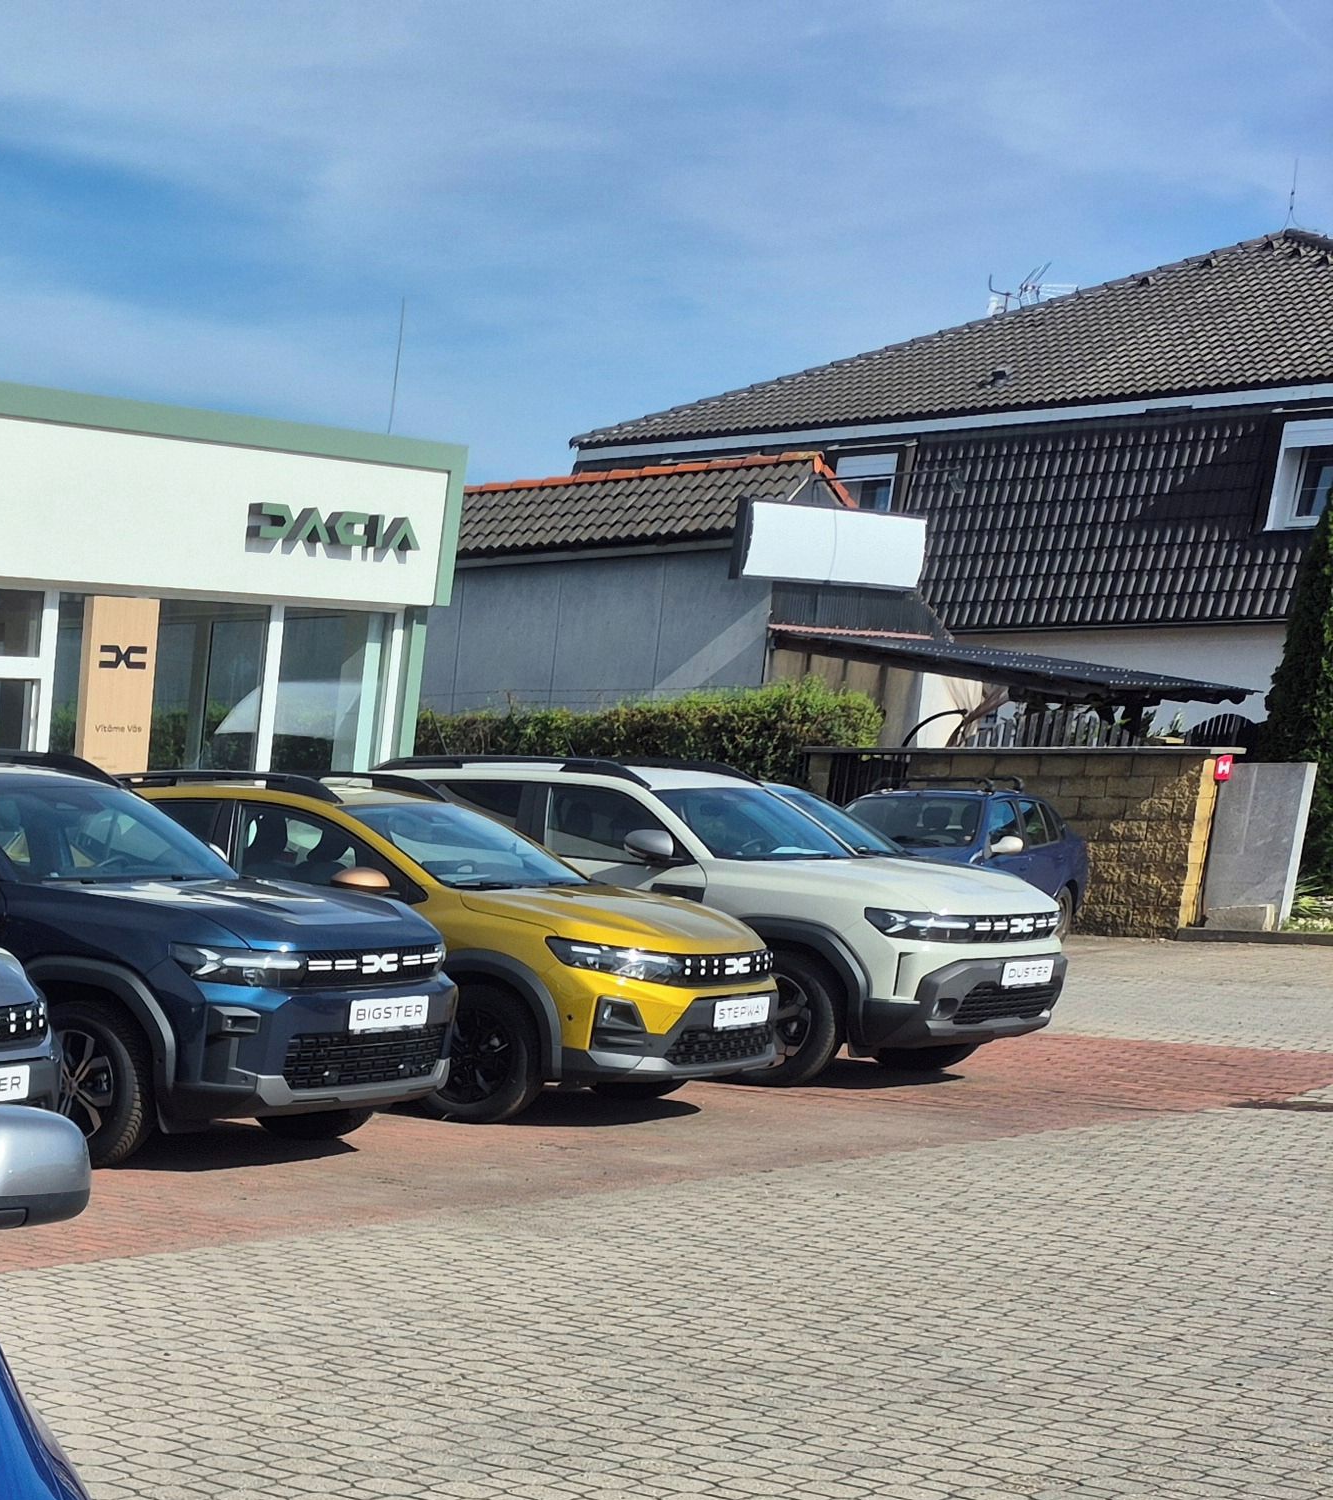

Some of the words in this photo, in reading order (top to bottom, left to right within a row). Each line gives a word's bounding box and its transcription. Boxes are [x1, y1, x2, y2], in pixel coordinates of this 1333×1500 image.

[247, 502, 420, 552] DACIA
[95, 723, 125, 733] Vítáme
[126, 723, 143, 733] Vás
[1218, 761, 1230, 775] H
[1008, 966, 1049, 979] DUSTER
[356, 1005, 423, 1021] BIGSTER
[718, 1004, 765, 1020] STEPWAY
